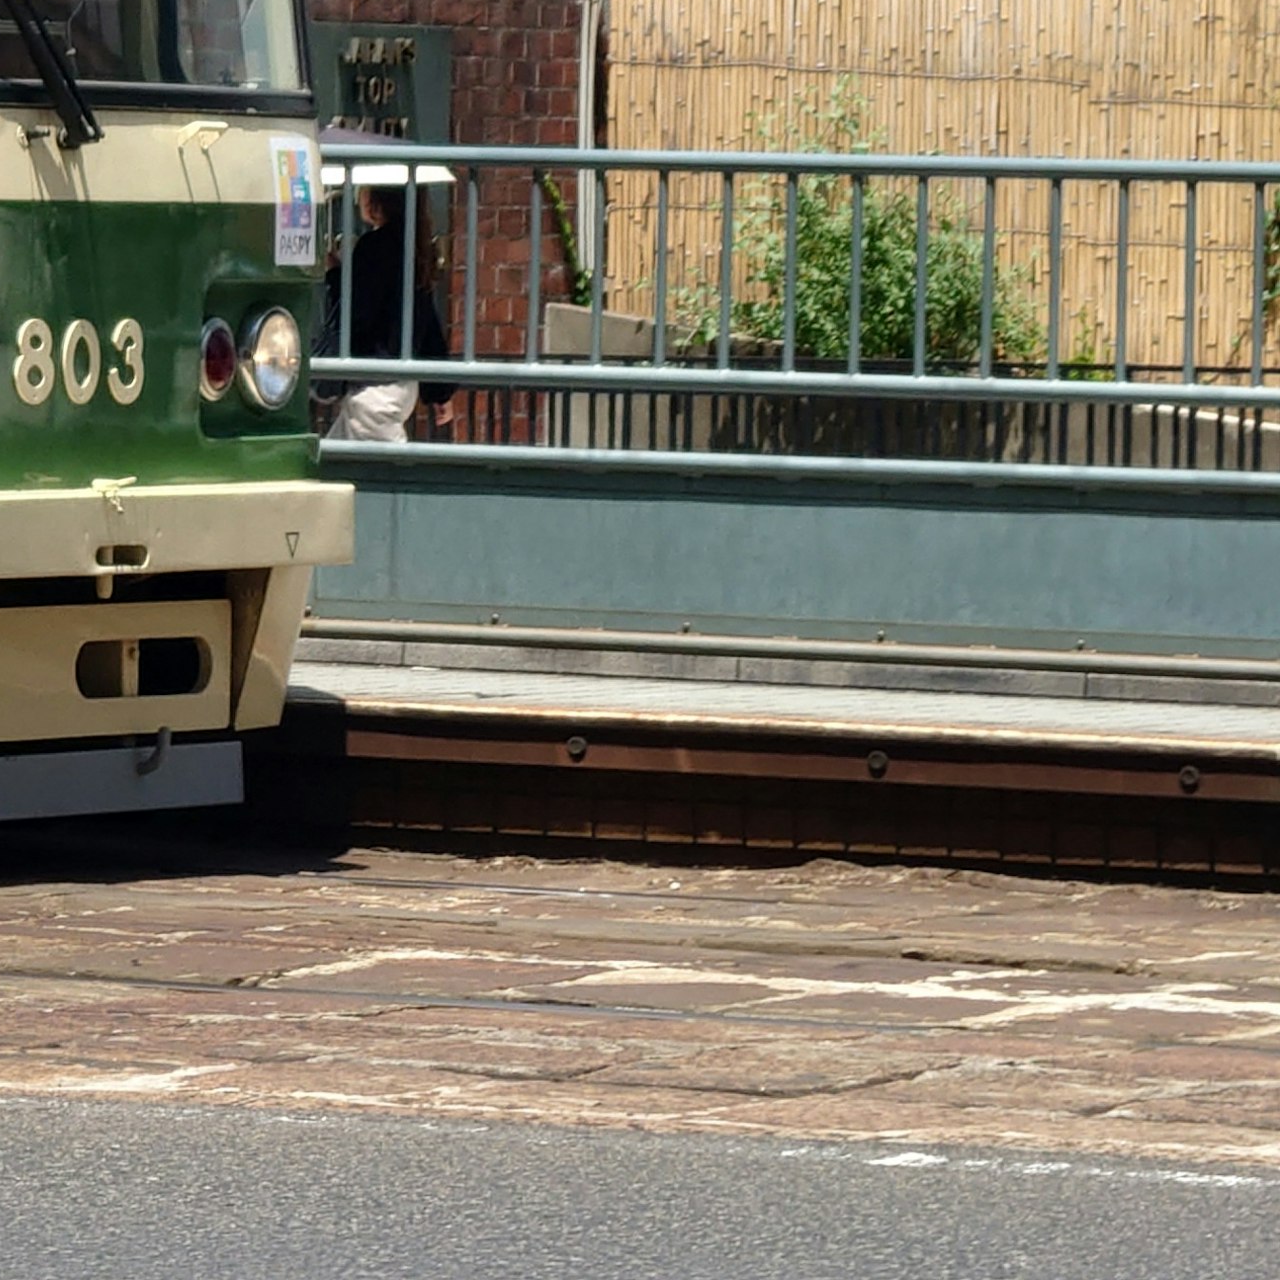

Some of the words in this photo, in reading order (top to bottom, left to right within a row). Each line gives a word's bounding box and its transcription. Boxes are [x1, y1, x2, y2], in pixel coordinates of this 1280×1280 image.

[356, 76, 396, 104] TOP
[280, 234, 312, 256] PASPY
[12, 317, 146, 406] 803
